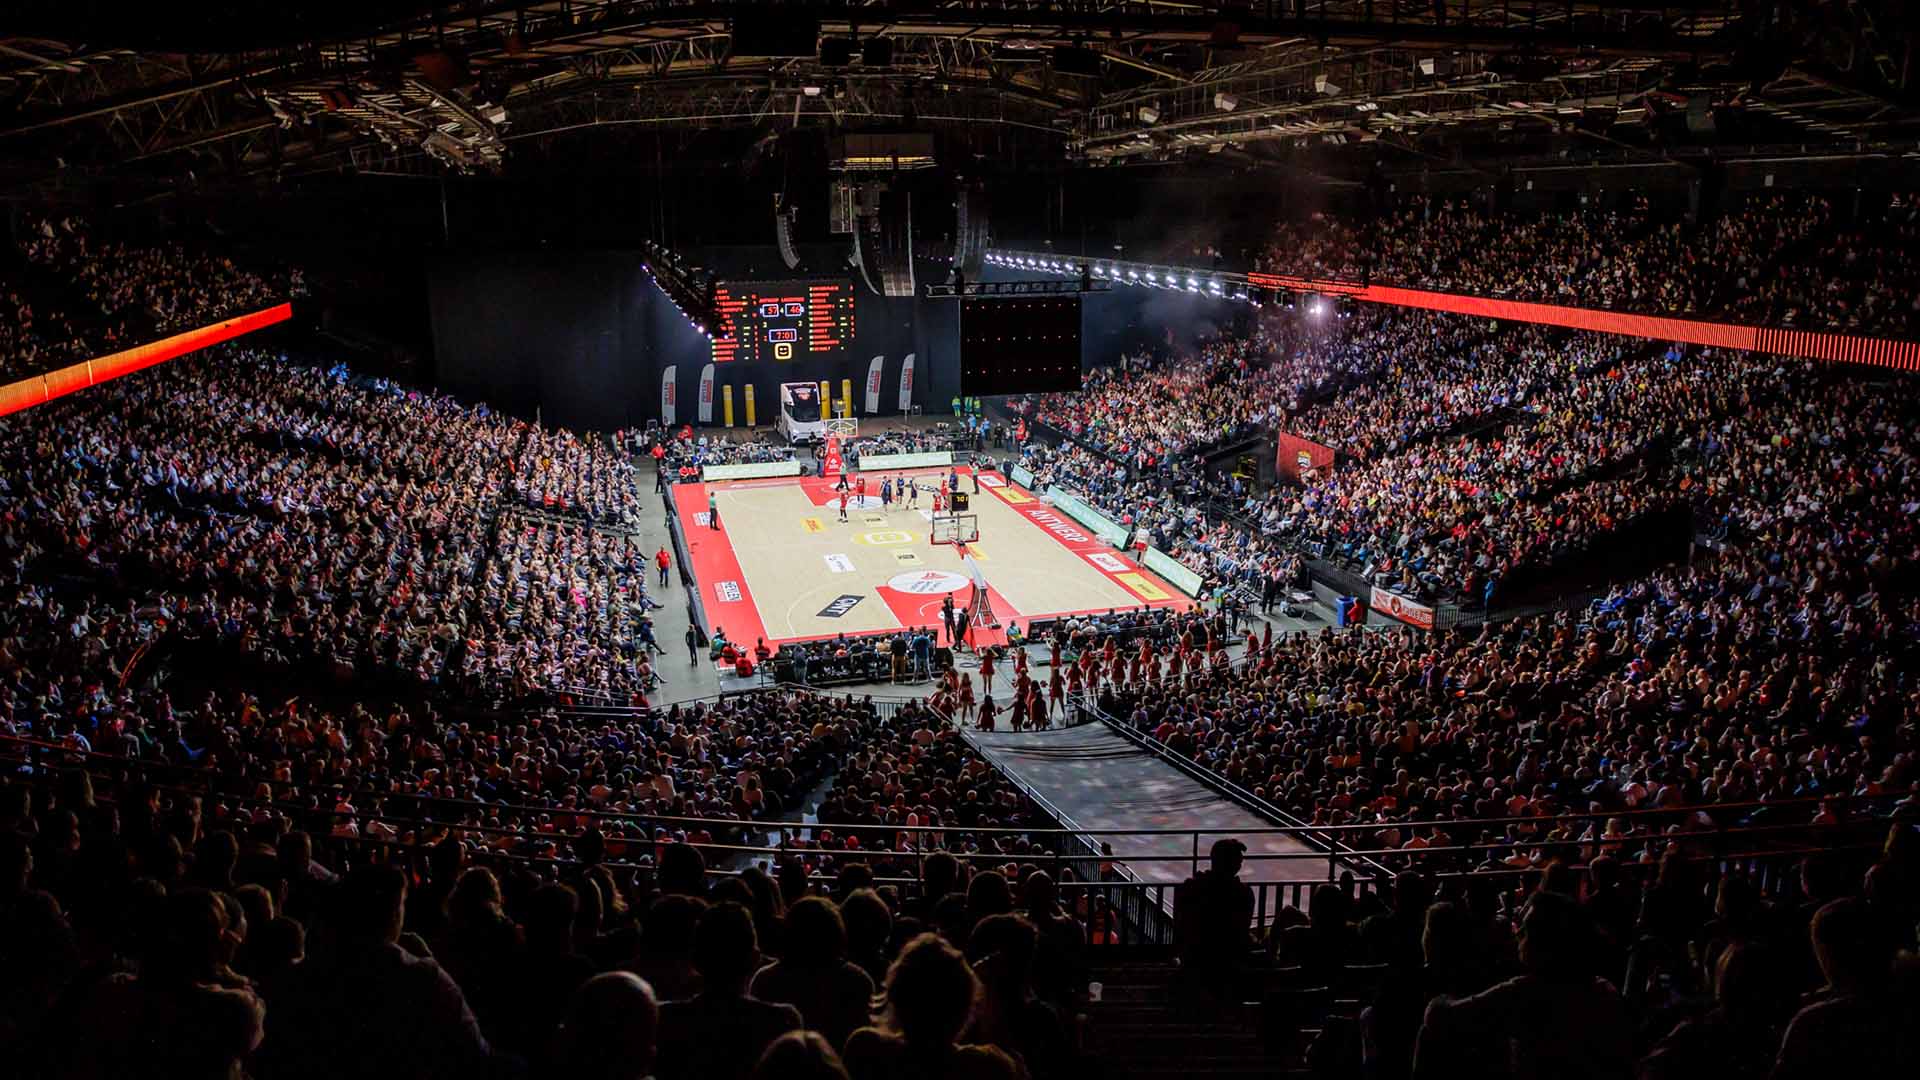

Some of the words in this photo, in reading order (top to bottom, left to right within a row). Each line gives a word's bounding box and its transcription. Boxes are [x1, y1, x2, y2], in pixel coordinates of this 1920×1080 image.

[768, 306, 777, 315] 57
[775, 332, 793, 340] 7:01
[1025, 510, 1088, 543] ANTWERP
